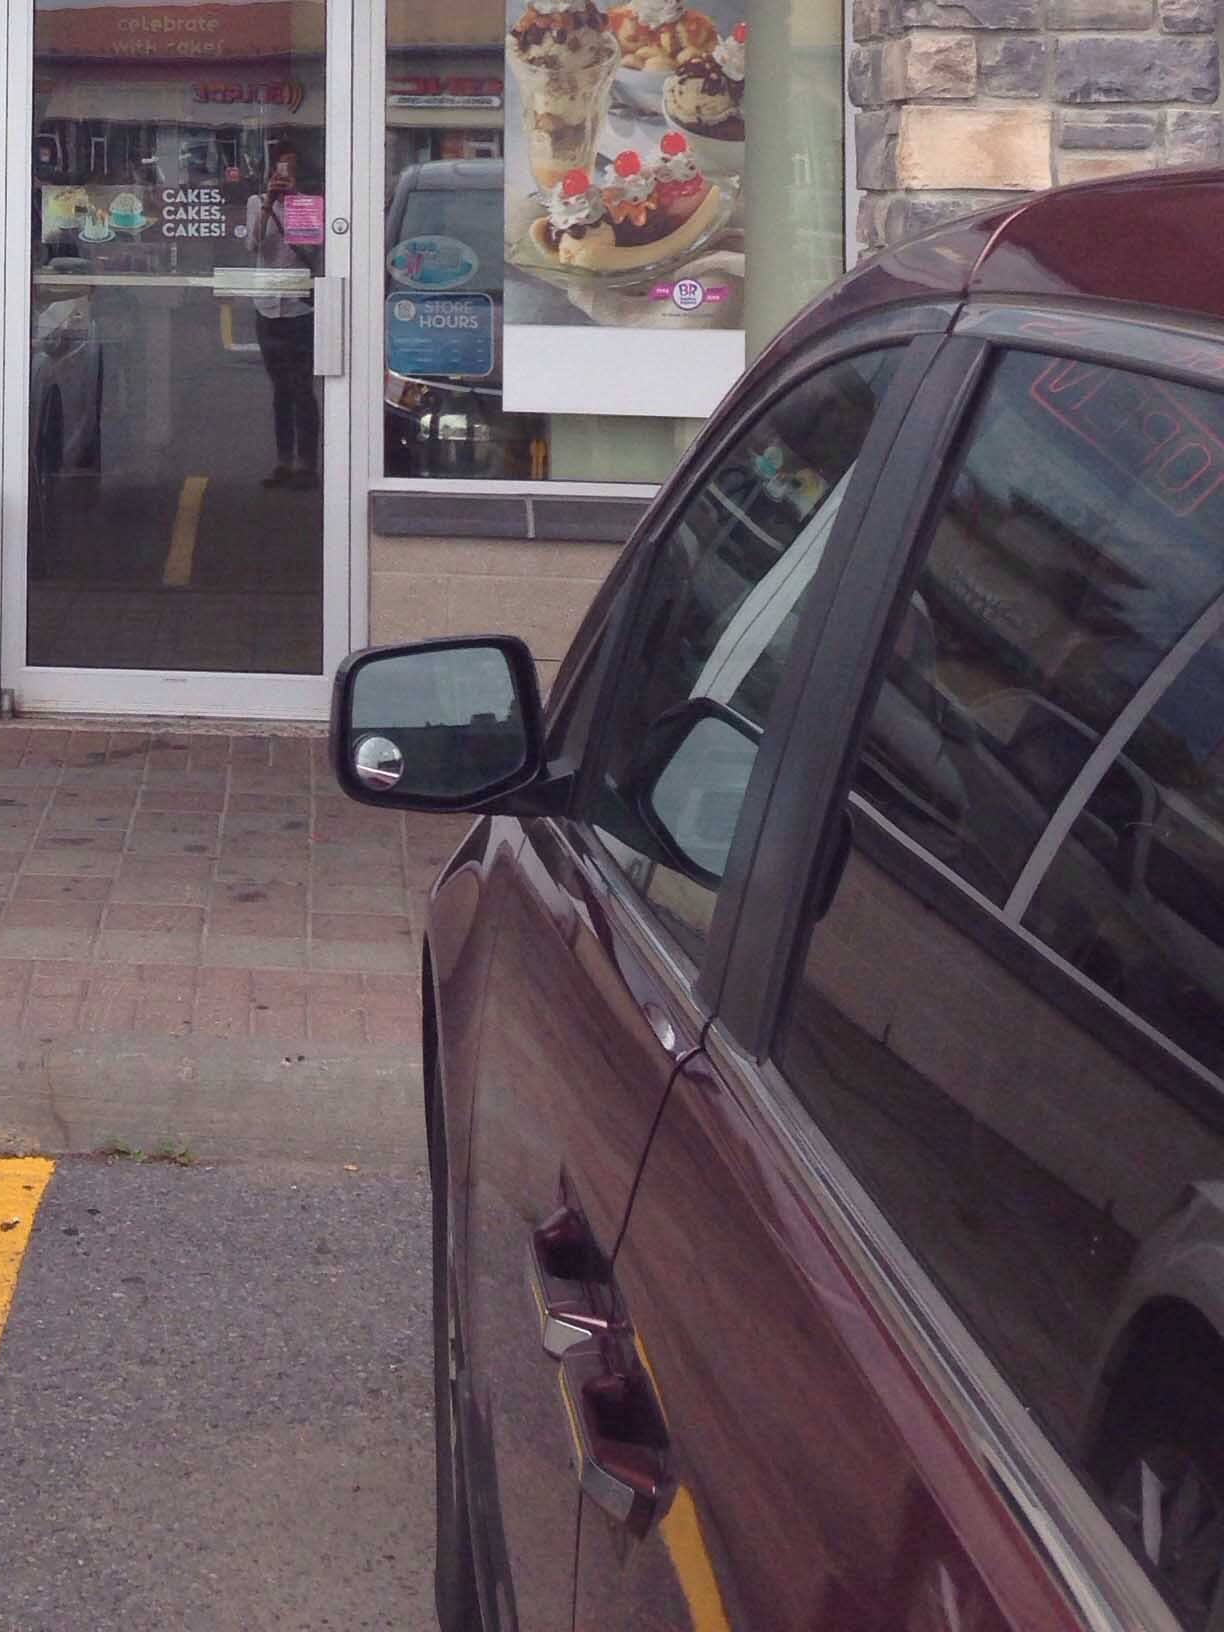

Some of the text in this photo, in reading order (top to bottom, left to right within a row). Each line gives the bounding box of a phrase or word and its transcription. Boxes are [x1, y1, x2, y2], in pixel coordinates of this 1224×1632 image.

[162, 189, 225, 204] CAKES,
[162, 206, 225, 221] CAKES,
[162, 223, 225, 237] CAKES!
[424, 301, 473, 313] STORE
[419, 315, 479, 329] HOURS
